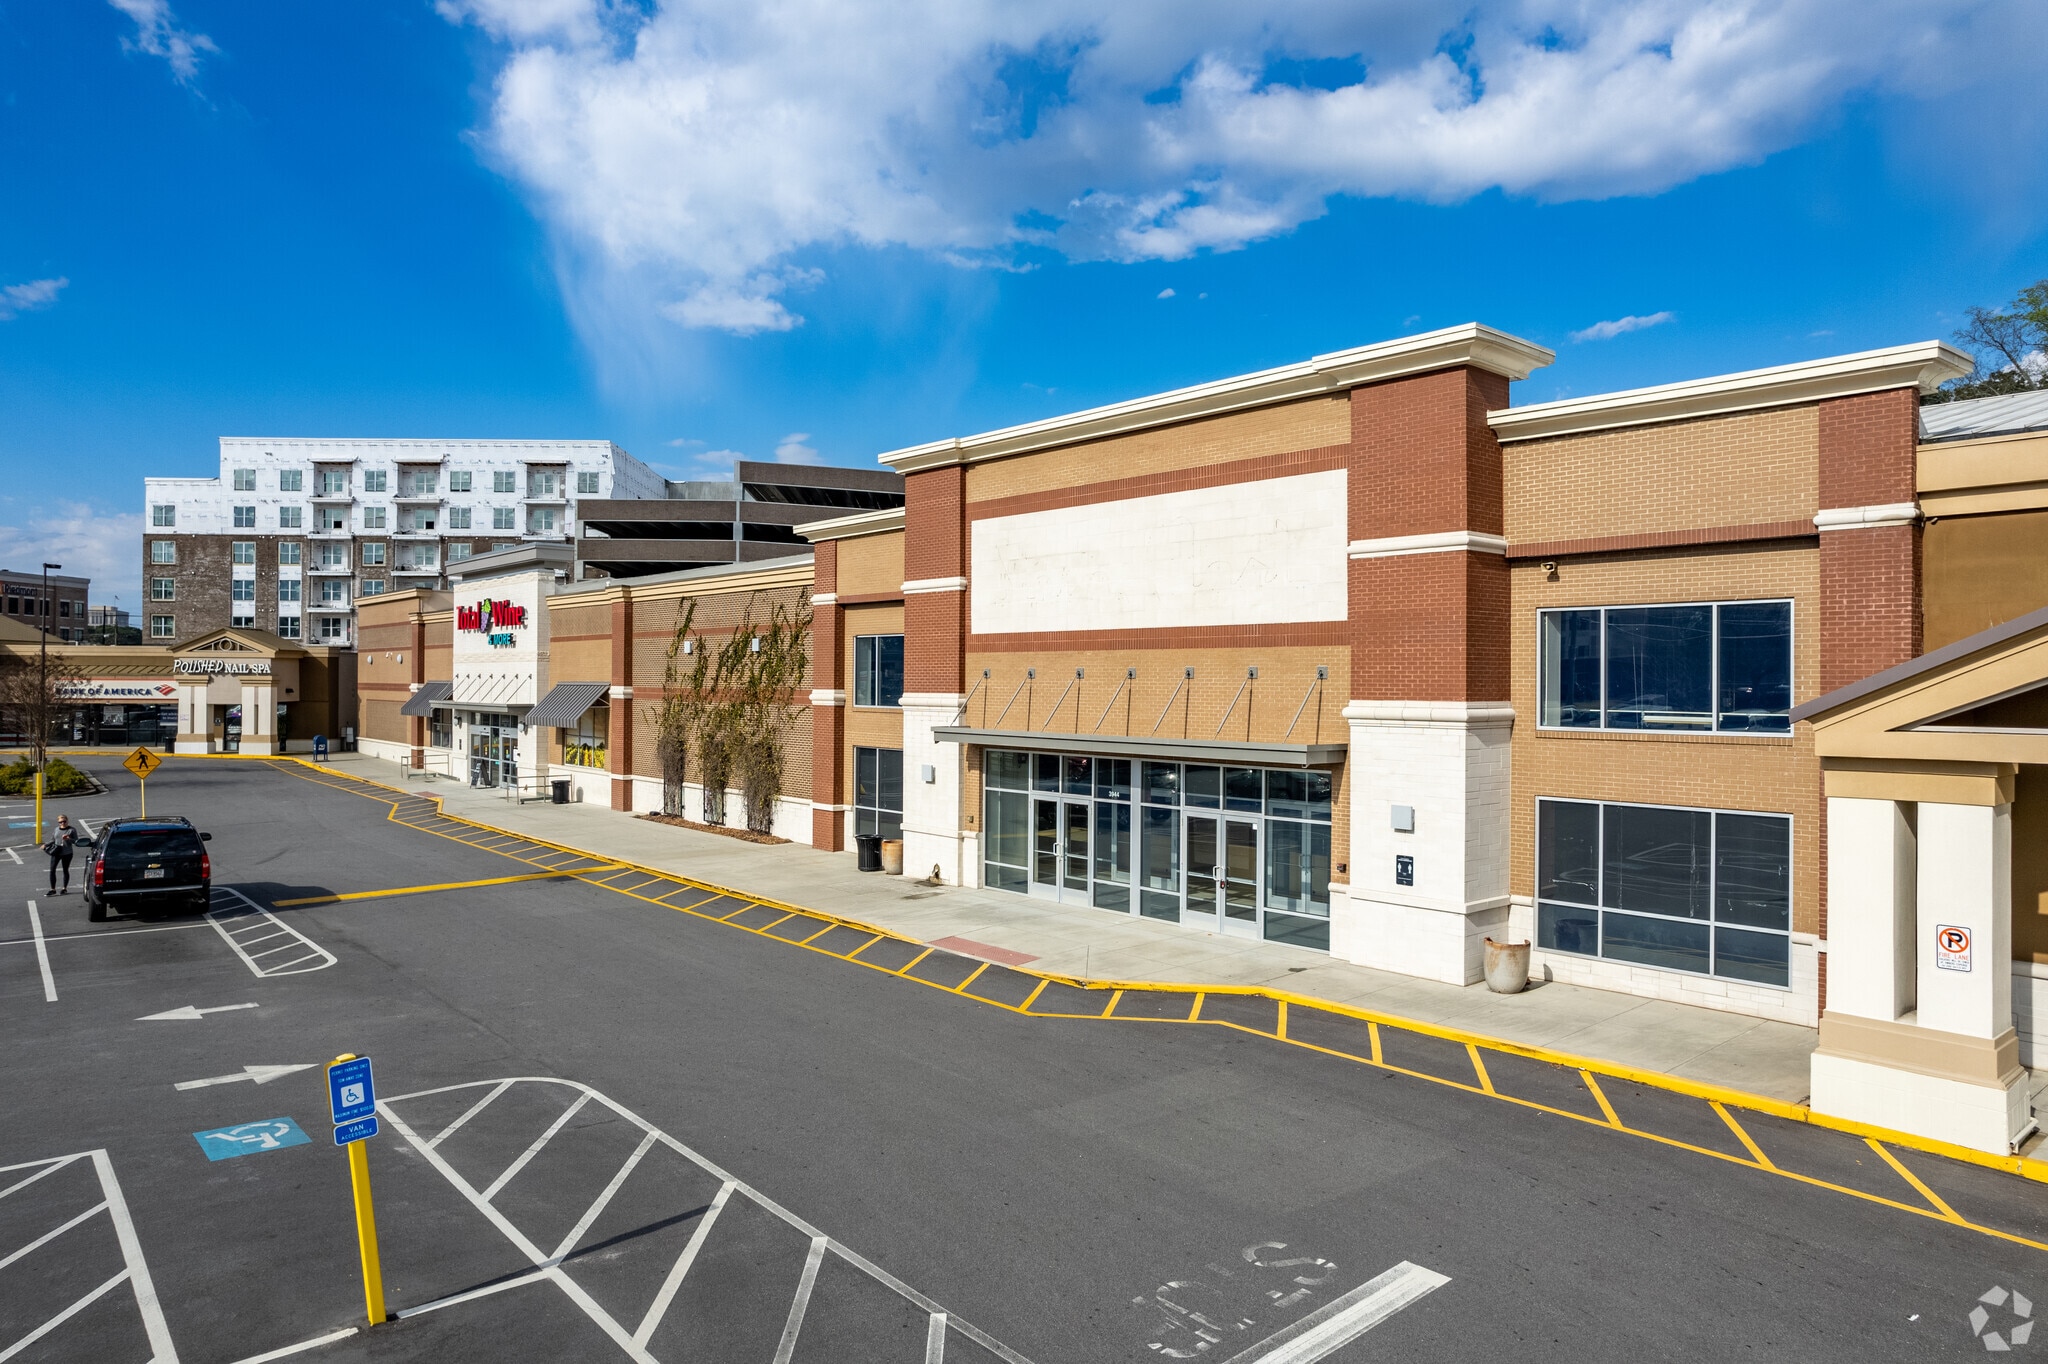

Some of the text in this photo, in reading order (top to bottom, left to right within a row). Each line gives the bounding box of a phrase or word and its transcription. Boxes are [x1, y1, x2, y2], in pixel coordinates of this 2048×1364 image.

[456, 599, 524, 630] Total Wine
[488, 633, 512, 645] & MORE
[173, 659, 271, 674] POLISHED NAIL SPA
[88, 687, 102, 697] OF
[104, 687, 153, 697] AMERICA
[344, 1065, 359, 1073] PARKING
[341, 1124, 374, 1141] VAN ACCESSIBLE
